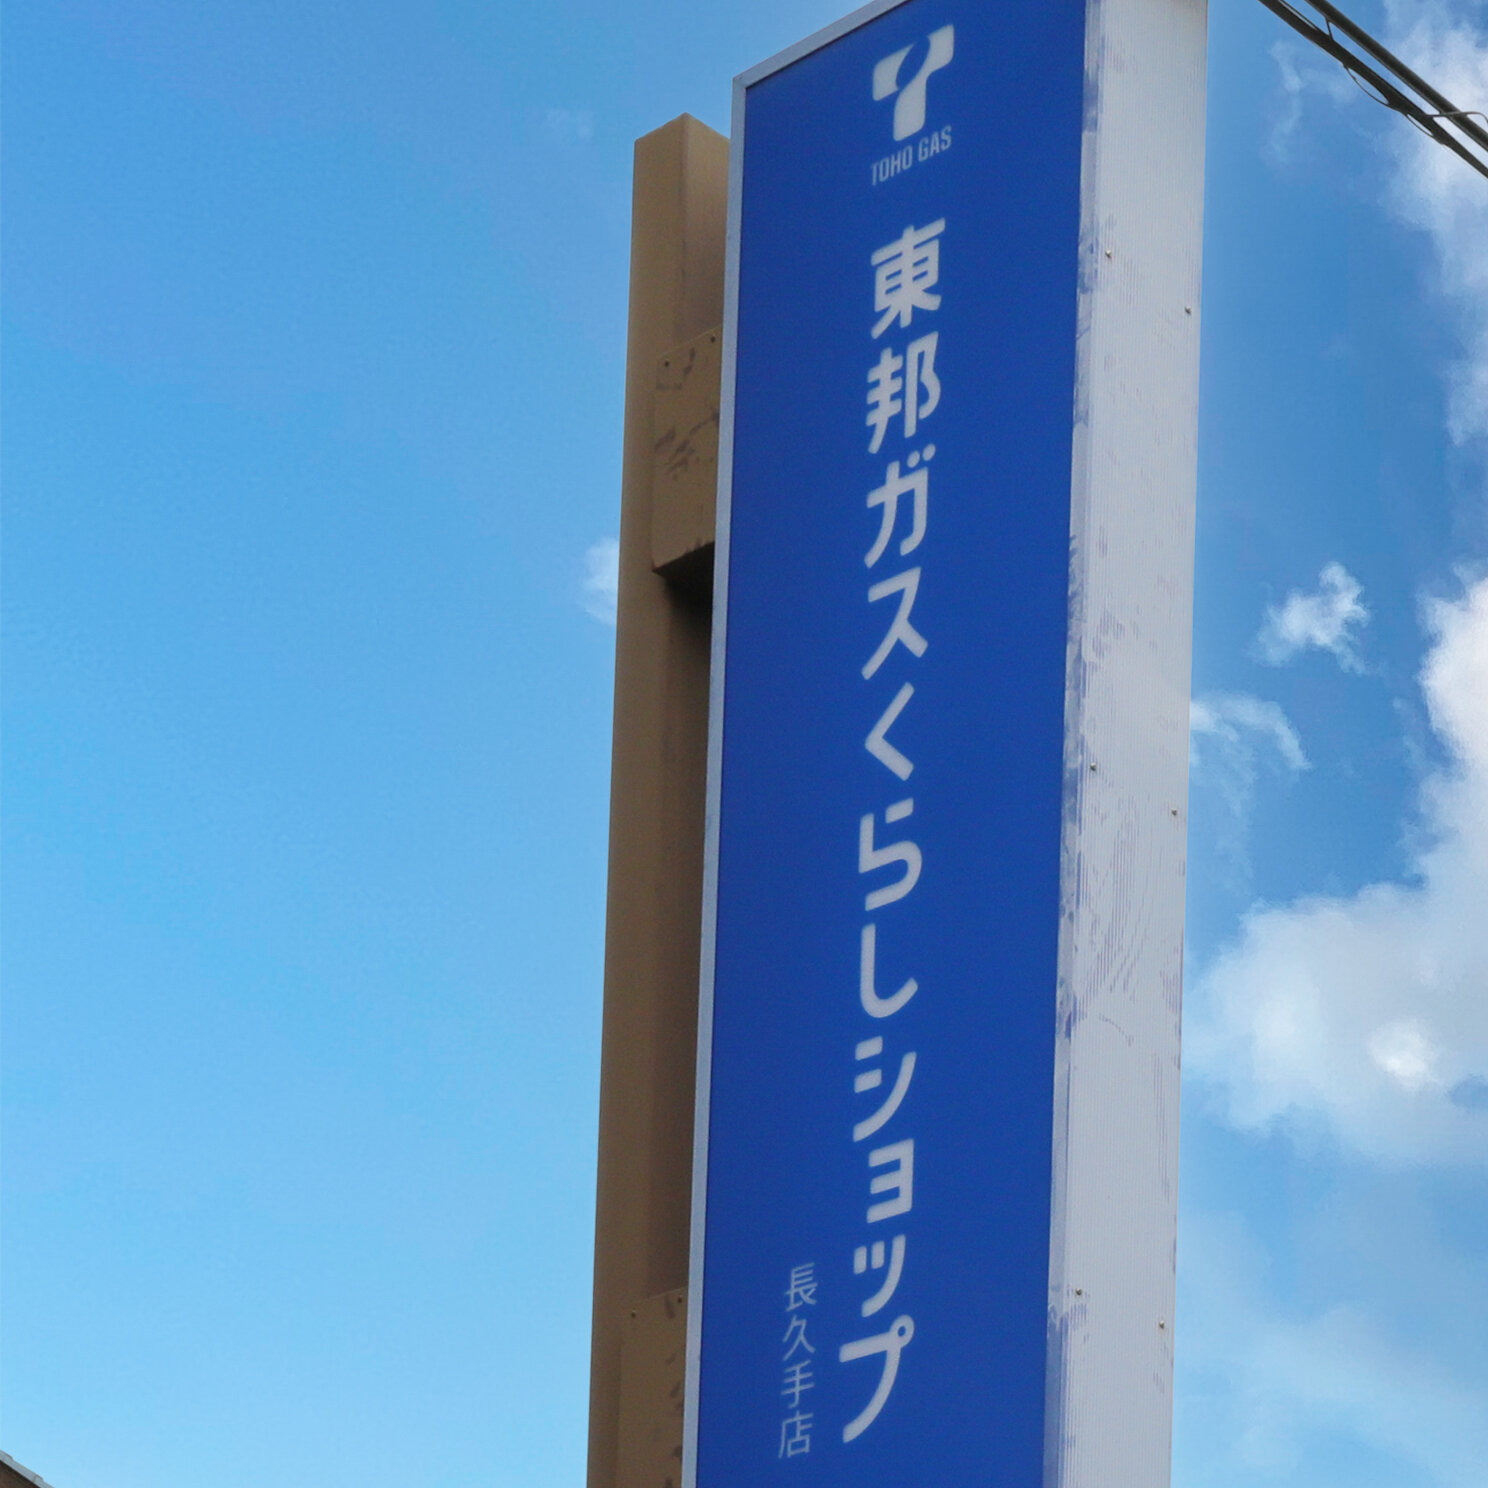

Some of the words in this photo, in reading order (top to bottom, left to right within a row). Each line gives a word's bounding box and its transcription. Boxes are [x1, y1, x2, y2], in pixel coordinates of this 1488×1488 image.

[871, 144, 913, 187] TOHO
[918, 124, 952, 162] GAS
[839, 217, 947, 1443] 東邦ガスくらしショップ
[778, 1262, 818, 1460] 長久手店
